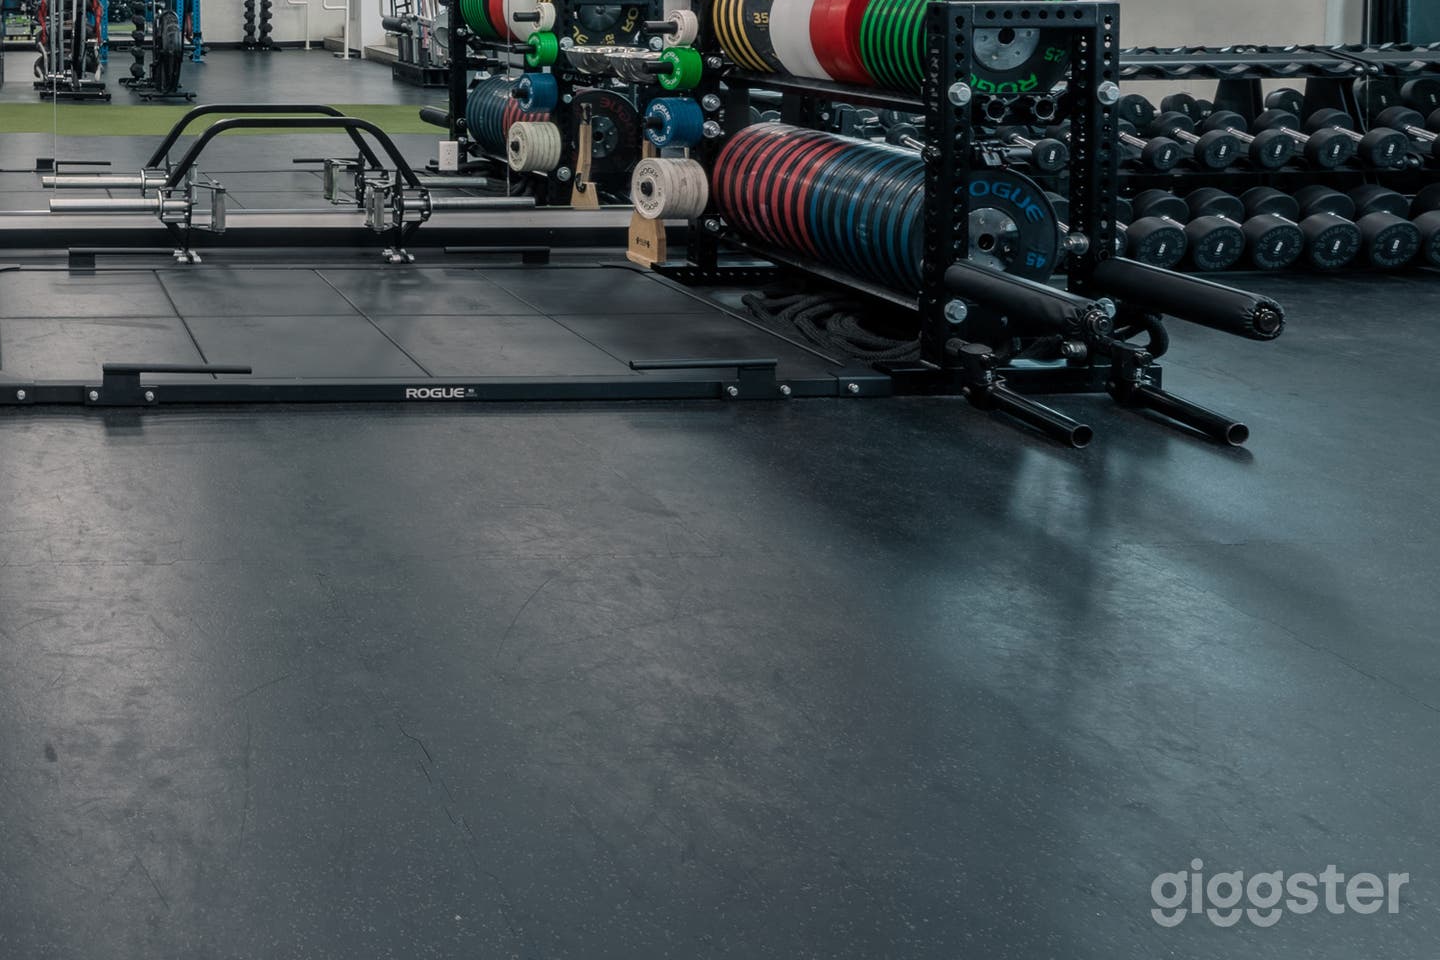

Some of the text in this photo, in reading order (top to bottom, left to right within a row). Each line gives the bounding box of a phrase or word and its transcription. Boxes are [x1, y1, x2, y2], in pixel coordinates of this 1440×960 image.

[753, 13, 769, 24] 35
[1044, 47, 1066, 63] 25
[968, 180, 1046, 223] OGUE
[1025, 251, 1047, 269] 45
[405, 387, 465, 399] ROGUE
